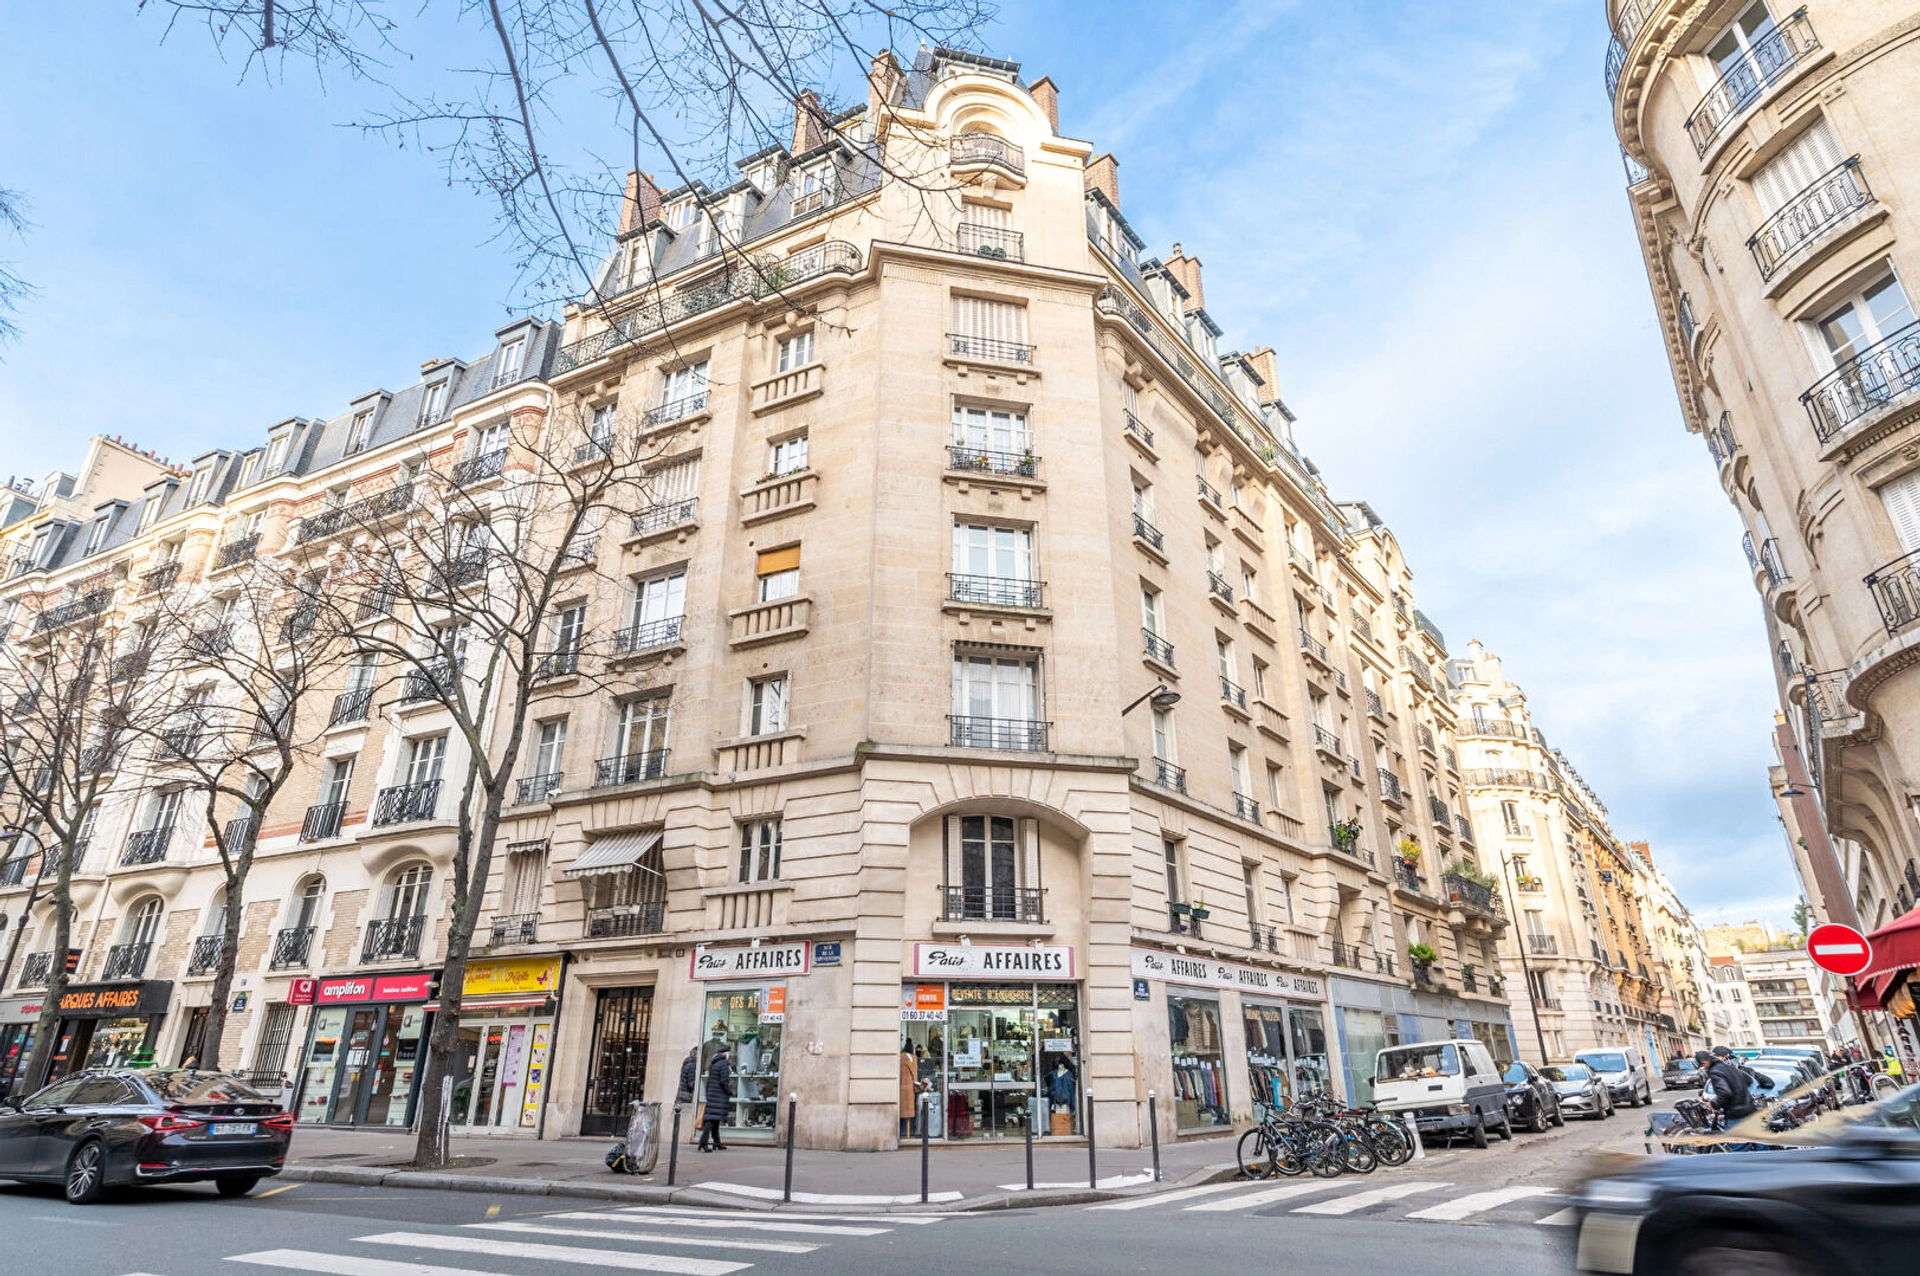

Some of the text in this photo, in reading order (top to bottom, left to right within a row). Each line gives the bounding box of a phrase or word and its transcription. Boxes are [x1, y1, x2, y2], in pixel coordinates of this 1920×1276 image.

[698, 949, 802, 970] Paris AFFAIRES
[928, 949, 1063, 971] Paris AFFAIRES
[1171, 958, 1207, 979] AFFAIRES
[1239, 970, 1268, 987] AFFAIRES
[1293, 978, 1318, 994] AFFAIRES
[324, 981, 366, 998] amplifon
[951, 988, 982, 1000] REVENTE
[95, 990, 140, 1007] AFFAIRES
[902, 1011, 943, 1020] 01 60 37 40 40
